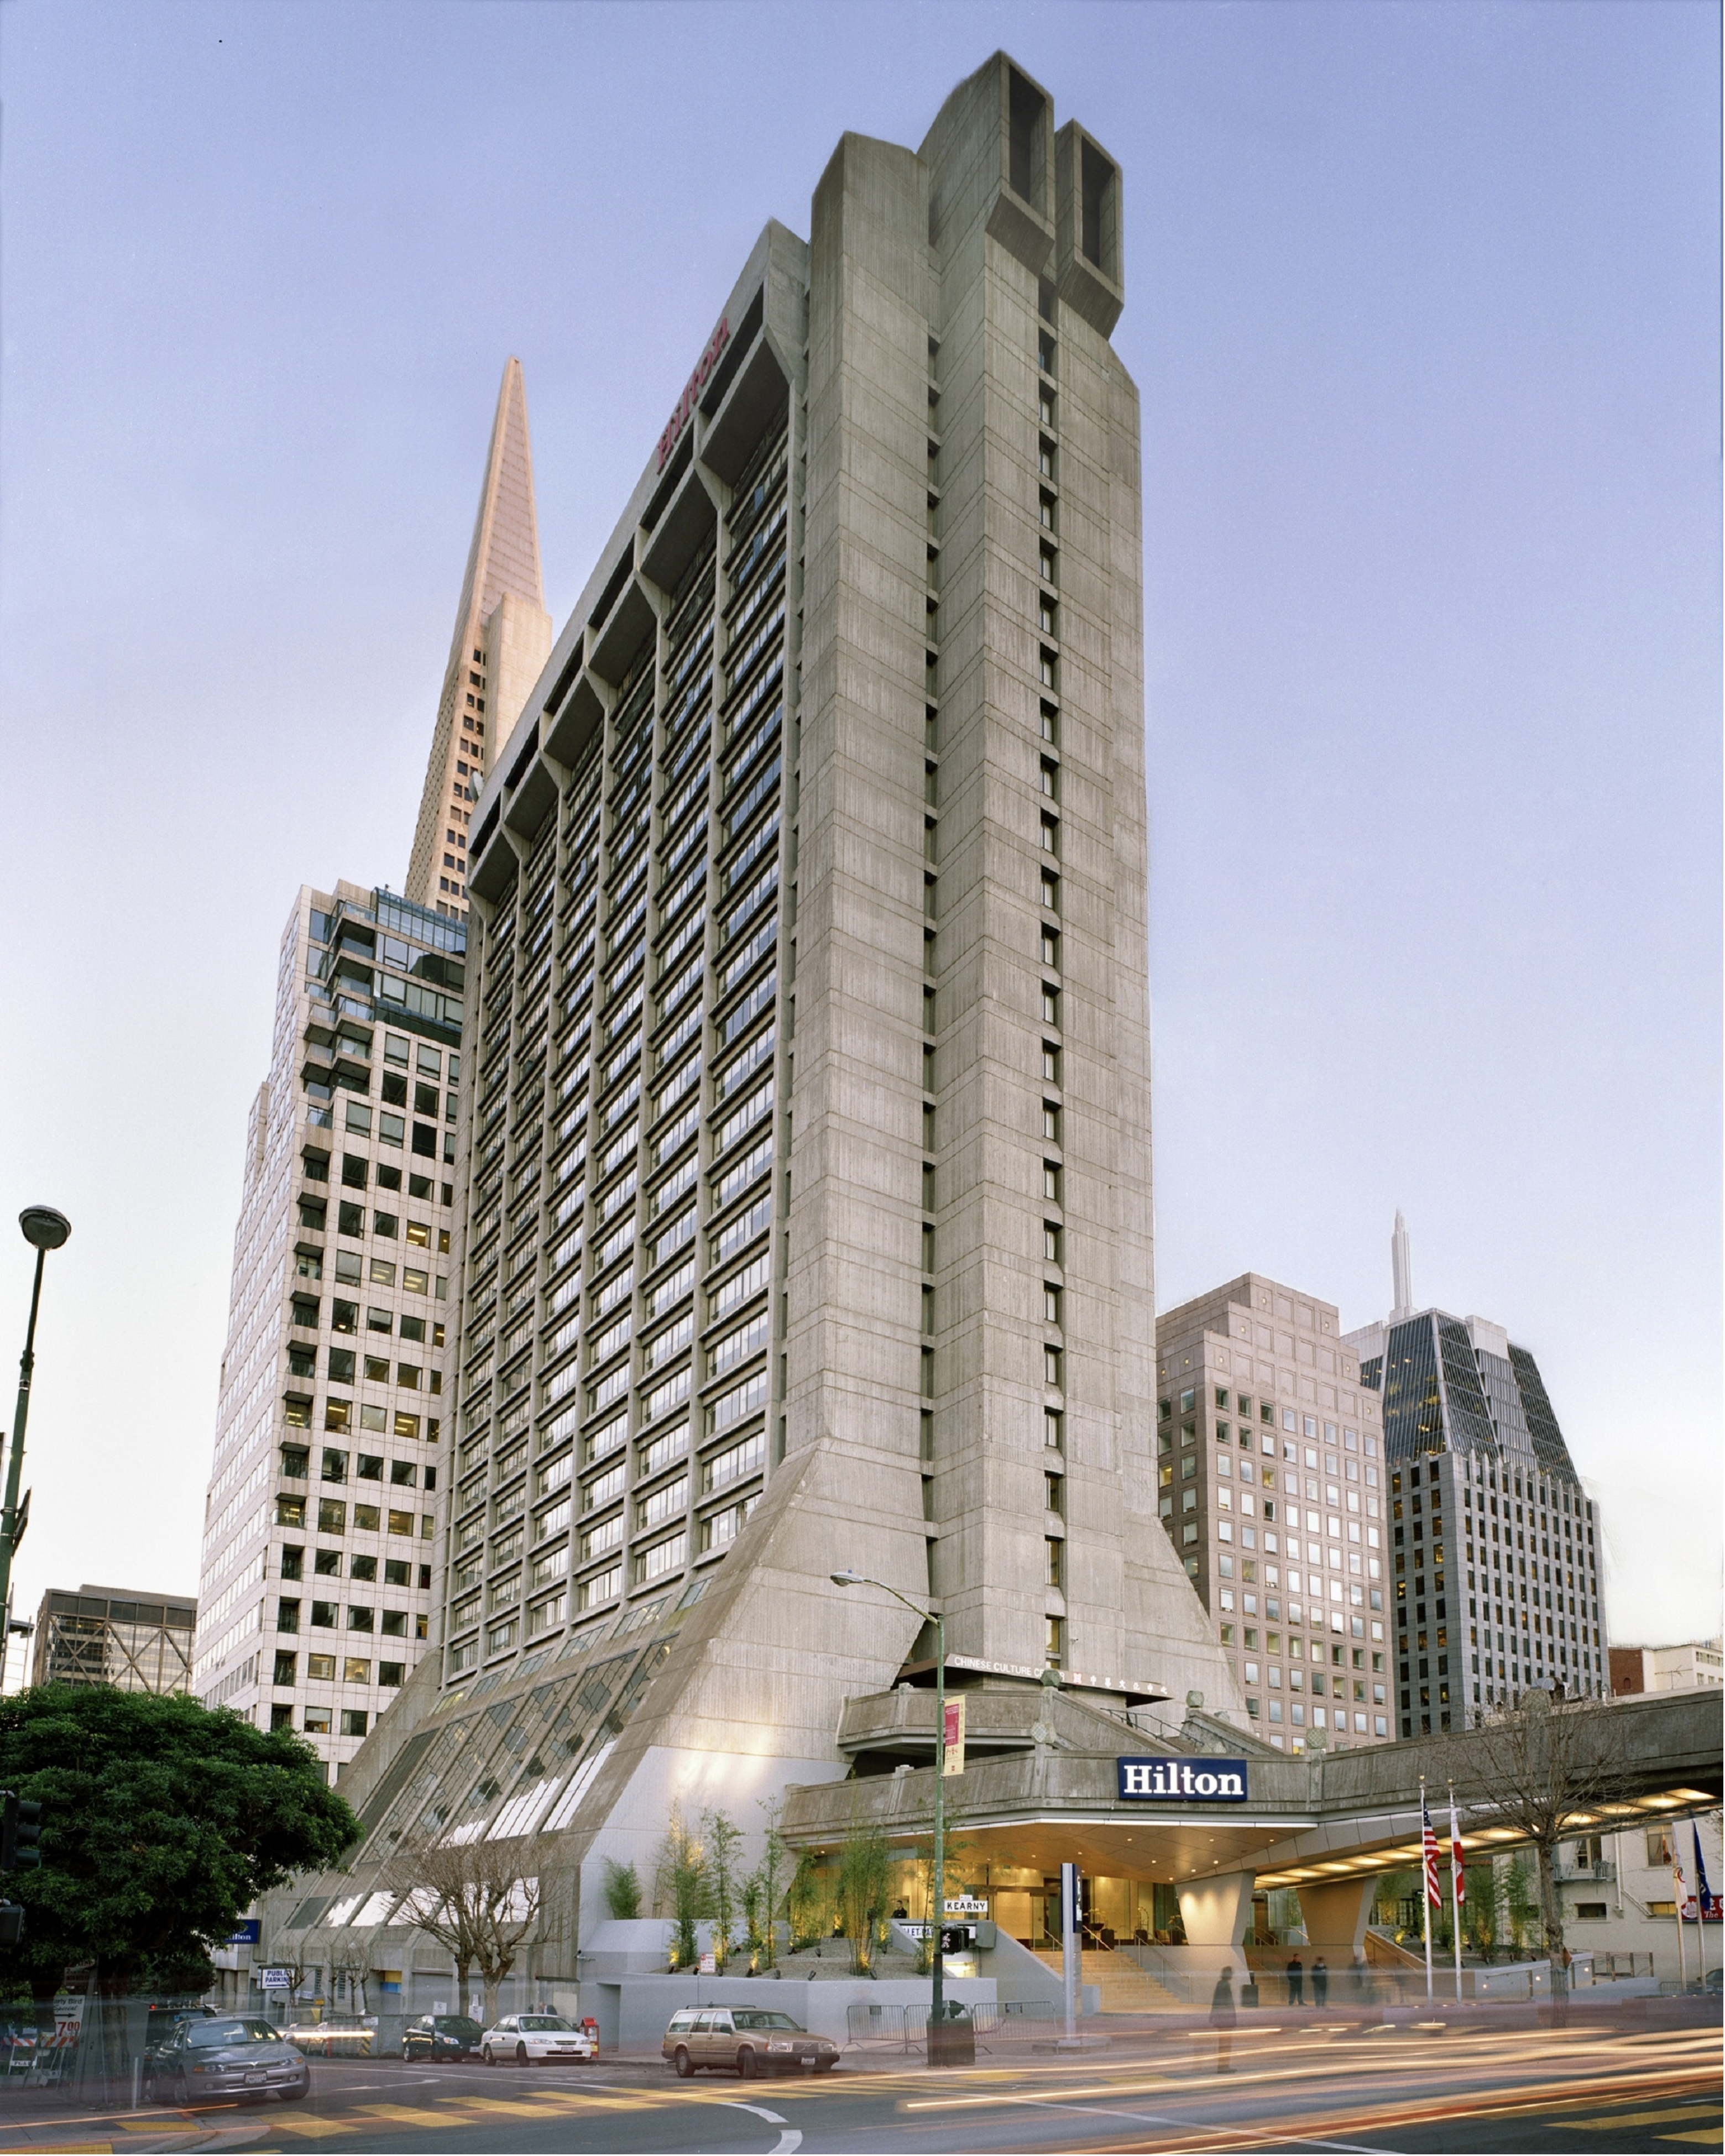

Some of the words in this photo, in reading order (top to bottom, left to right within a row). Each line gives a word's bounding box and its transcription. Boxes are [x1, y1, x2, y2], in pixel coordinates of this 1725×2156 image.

[656, 317, 730, 475] Hilton
[954, 1656, 991, 1670] CHINESE
[993, 1662, 1032, 1676] CULTURE
[1034, 1668, 1065, 1681] CER
[1123, 1762, 1245, 1795] Hilton
[947, 1902, 985, 1910] KEARNY
